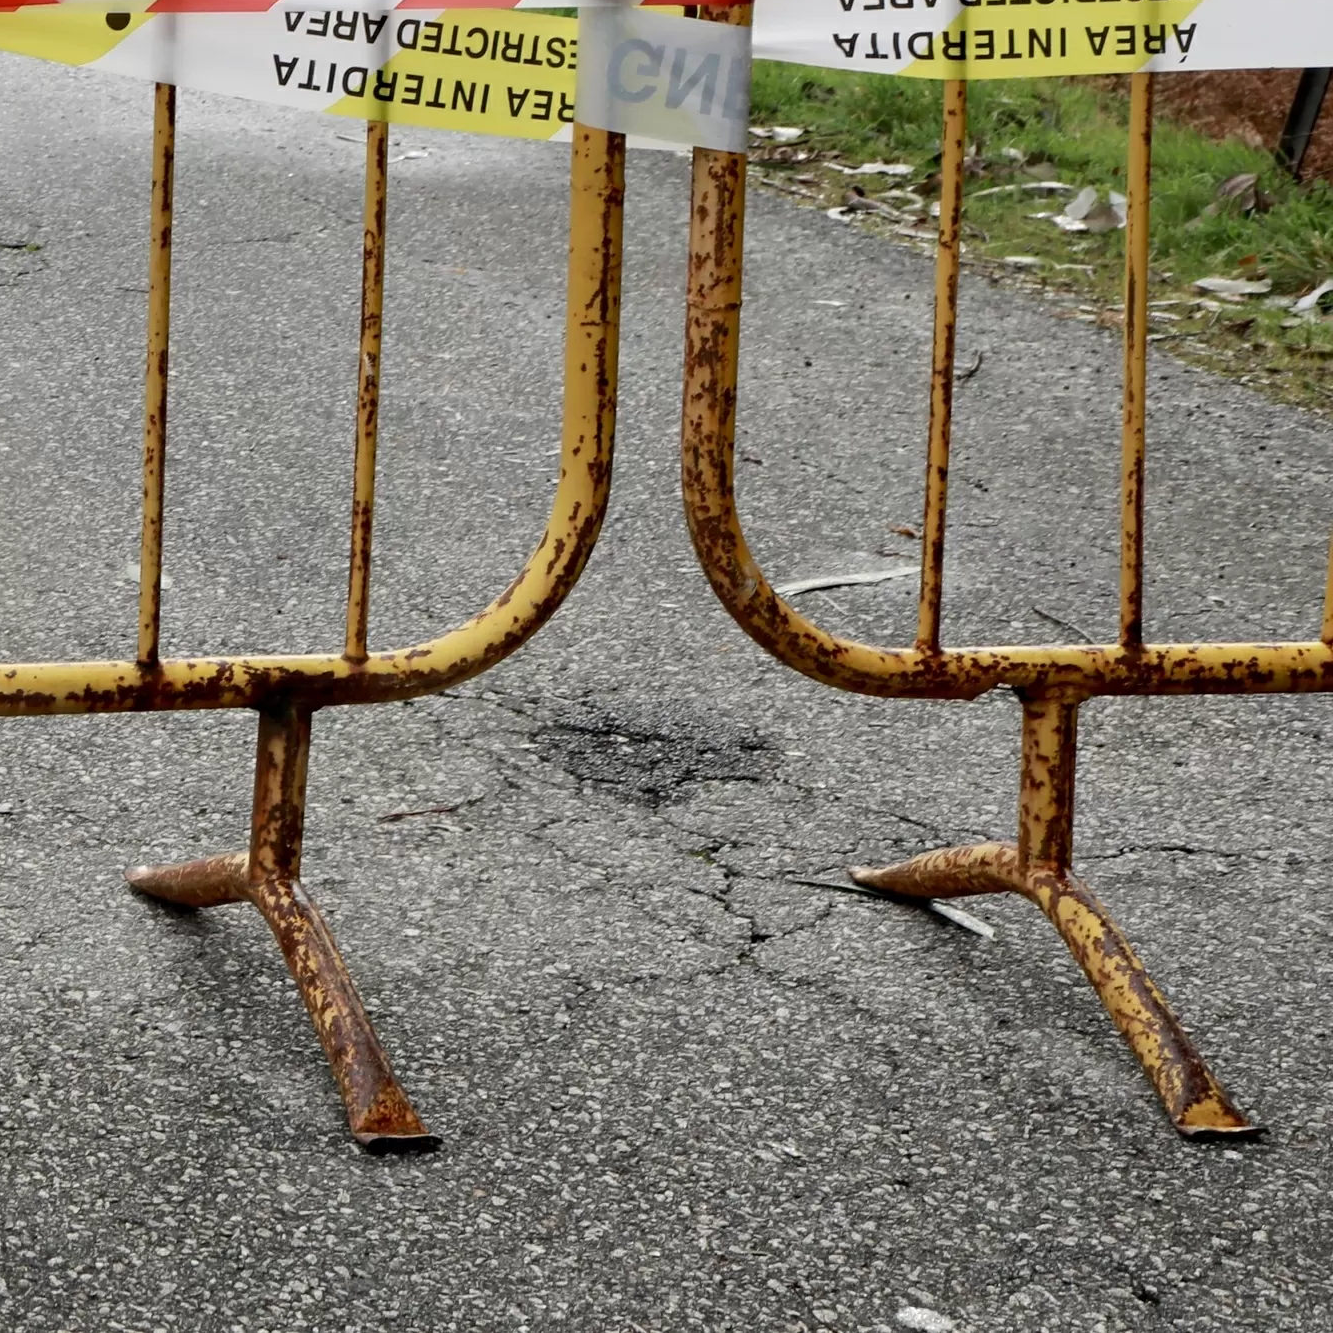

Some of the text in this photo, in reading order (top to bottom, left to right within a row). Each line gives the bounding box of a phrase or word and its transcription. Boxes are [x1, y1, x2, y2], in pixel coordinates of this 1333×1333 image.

[832, 23, 1199, 63] ÁREA INTERDITA
[273, 54, 491, 114] INTERDITA
